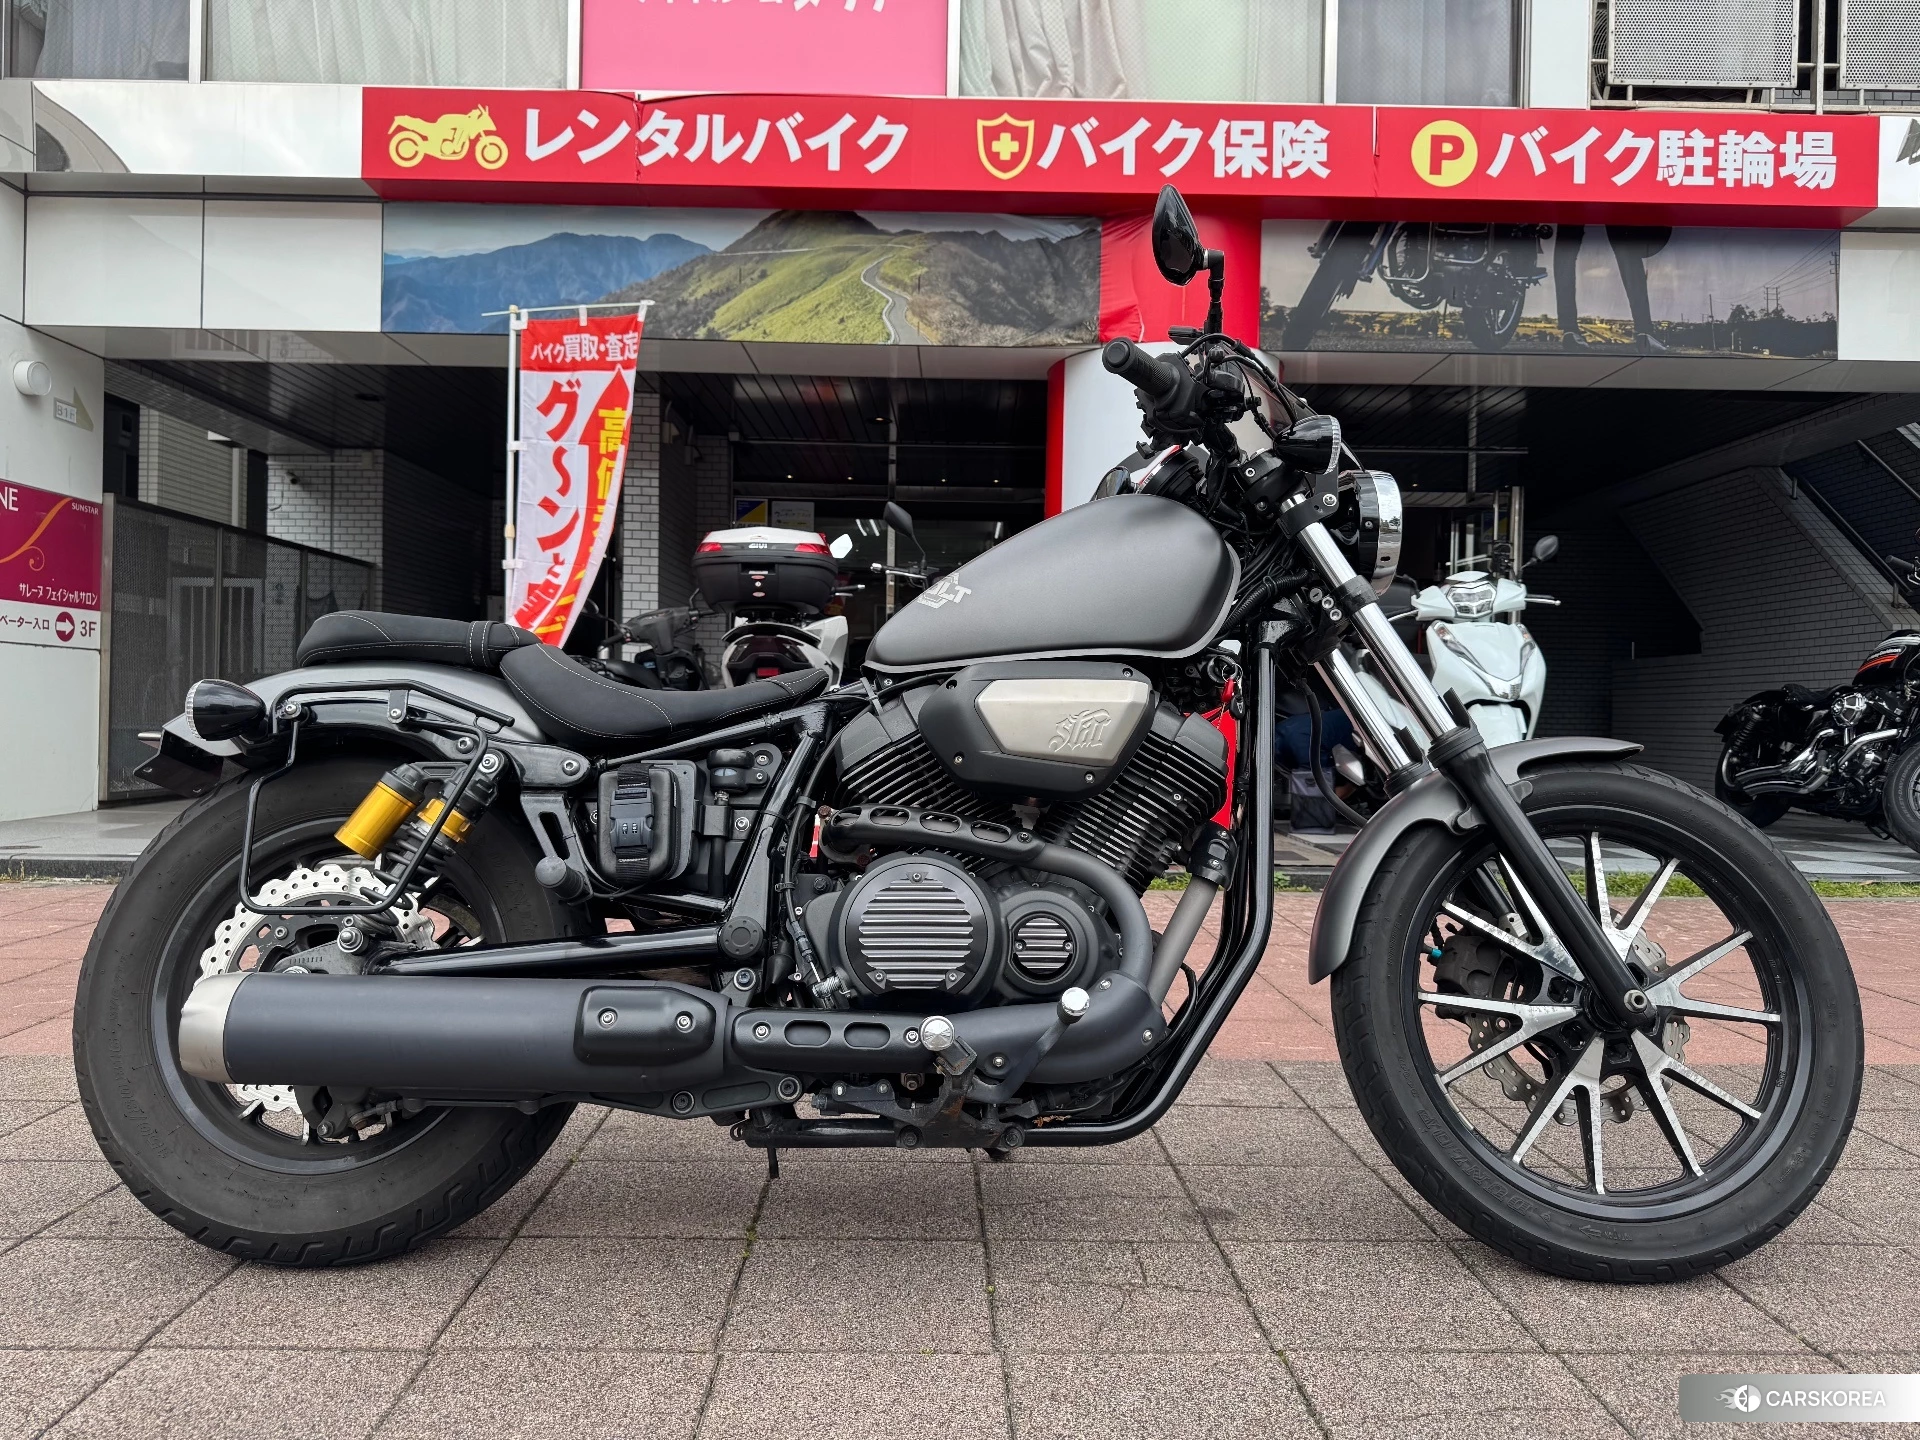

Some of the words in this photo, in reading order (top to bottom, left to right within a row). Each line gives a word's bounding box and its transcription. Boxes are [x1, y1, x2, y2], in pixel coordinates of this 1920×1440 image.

[524, 106, 908, 173] レンタルバイク
[1037, 117, 1330, 180] バイク保険
[1486, 126, 1838, 191] バイク駐輪場
[71, 502, 99, 515] SUNSTAR
[19, 582, 44, 599] サレーヌ
[46, 586, 98, 606] フェイシャルサロン
[80, 620, 97, 637] 3F
